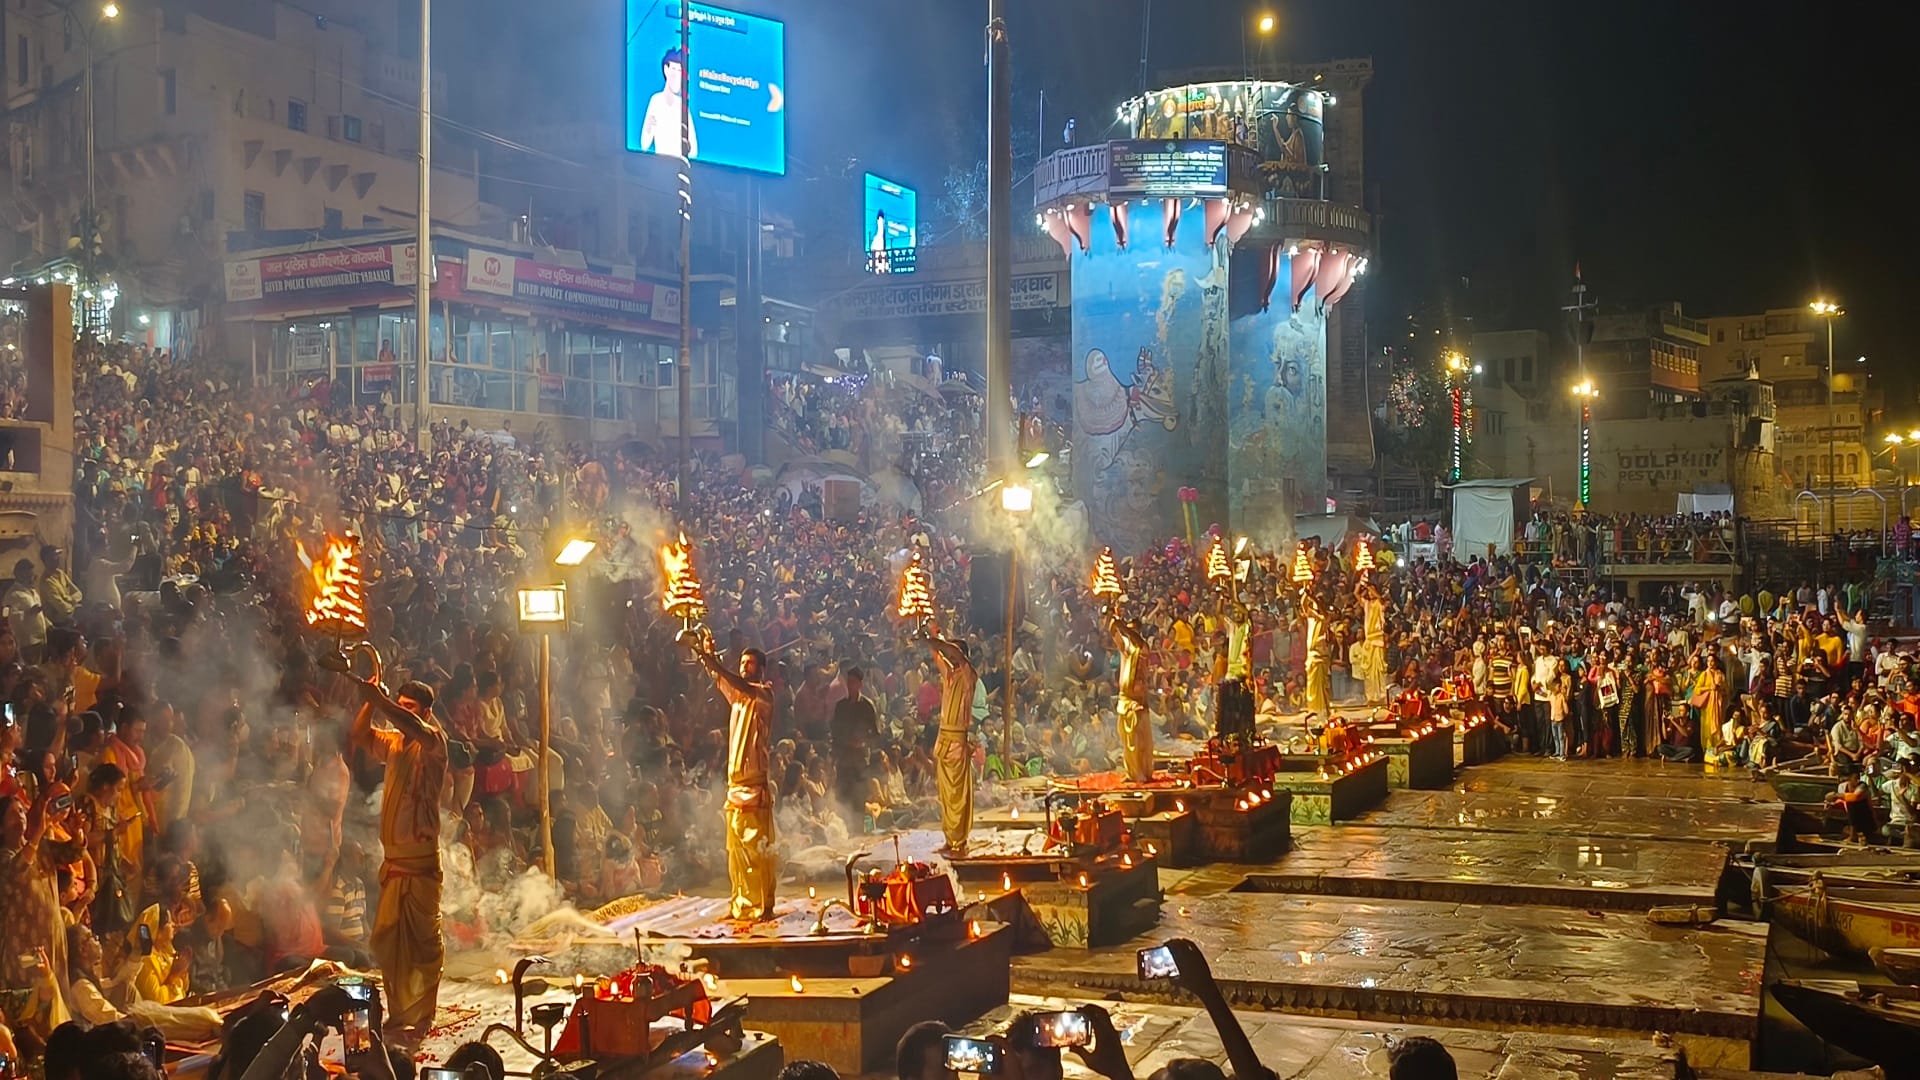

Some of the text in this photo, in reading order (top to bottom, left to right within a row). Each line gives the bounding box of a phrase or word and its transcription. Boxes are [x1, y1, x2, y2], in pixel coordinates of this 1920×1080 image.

[284, 256, 308, 276] पुलिस
[284, 277, 305, 291] POLICE
[518, 281, 539, 296] RIVER
[540, 285, 563, 300] POLICE
[1029, 276, 1053, 291] घाट
